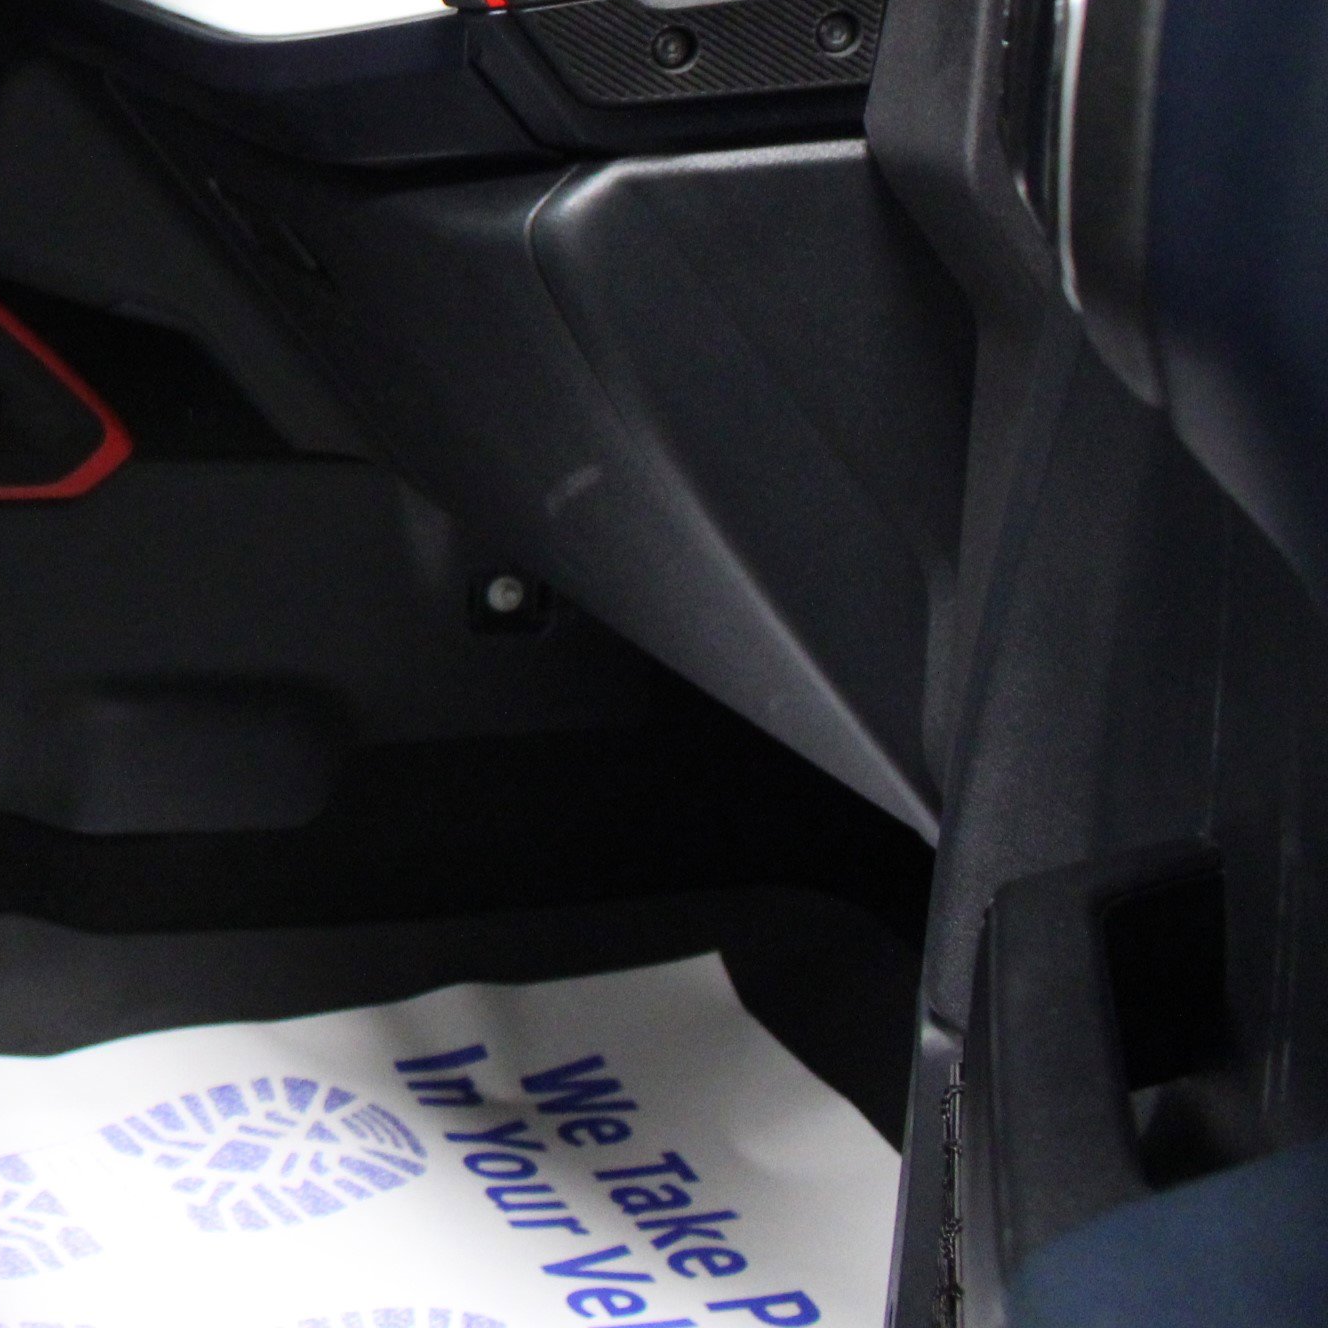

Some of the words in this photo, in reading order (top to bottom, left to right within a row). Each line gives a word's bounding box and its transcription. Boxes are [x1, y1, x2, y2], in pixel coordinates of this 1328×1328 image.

[394, 1043, 489, 1108] In
[443, 1119, 591, 1236] Your
[540, 1244, 698, 1328] Ve
[519, 1054, 638, 1149] We
[593, 1151, 749, 1280] Take
